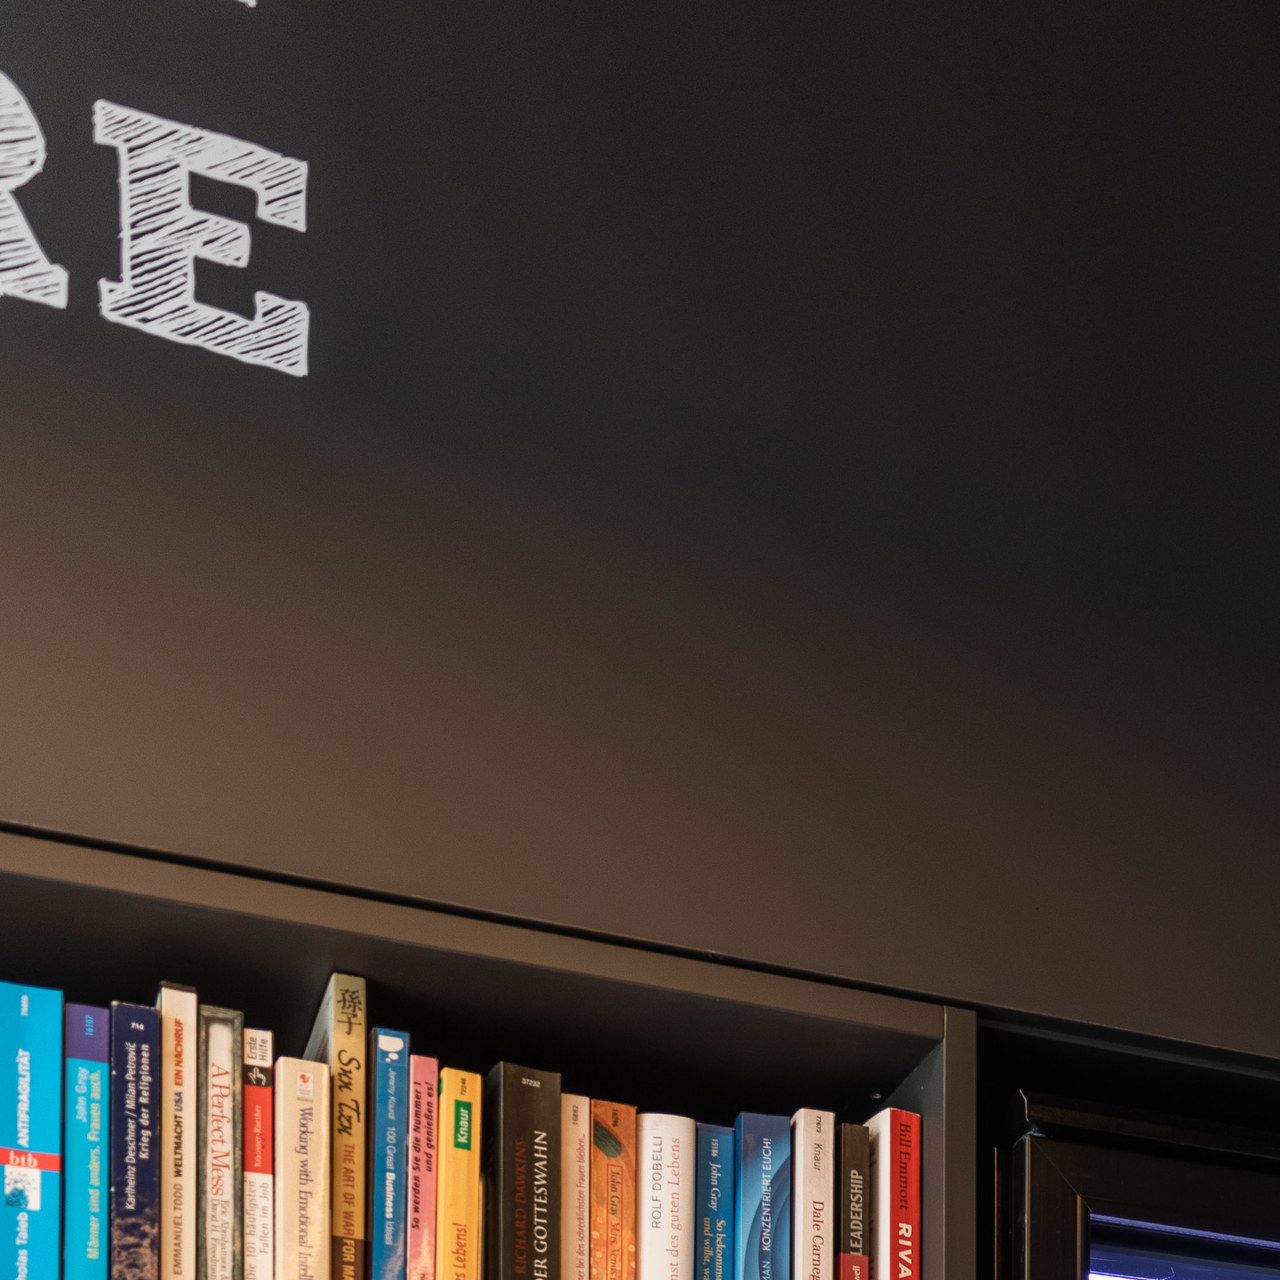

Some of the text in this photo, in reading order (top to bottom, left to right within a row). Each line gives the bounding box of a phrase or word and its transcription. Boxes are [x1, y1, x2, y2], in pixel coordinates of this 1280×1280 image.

[16, 1048, 30, 1147] ANTIFRAGILITÄT
[173, 1020, 184, 1178] WELTMACHT USA EIN NACHRUF
[455, 1105, 470, 1145] Knaur
[8, 1151, 38, 1169] btb
[533, 1131, 548, 1253] GOTTESWAHN
[651, 1136, 663, 1230] ROLF DOBELLI
[762, 1137, 772, 1172] EUCH!
[762, 1174, 772, 1252] KONZENTRIERT
[849, 1169, 864, 1256] LEADERSHIP
